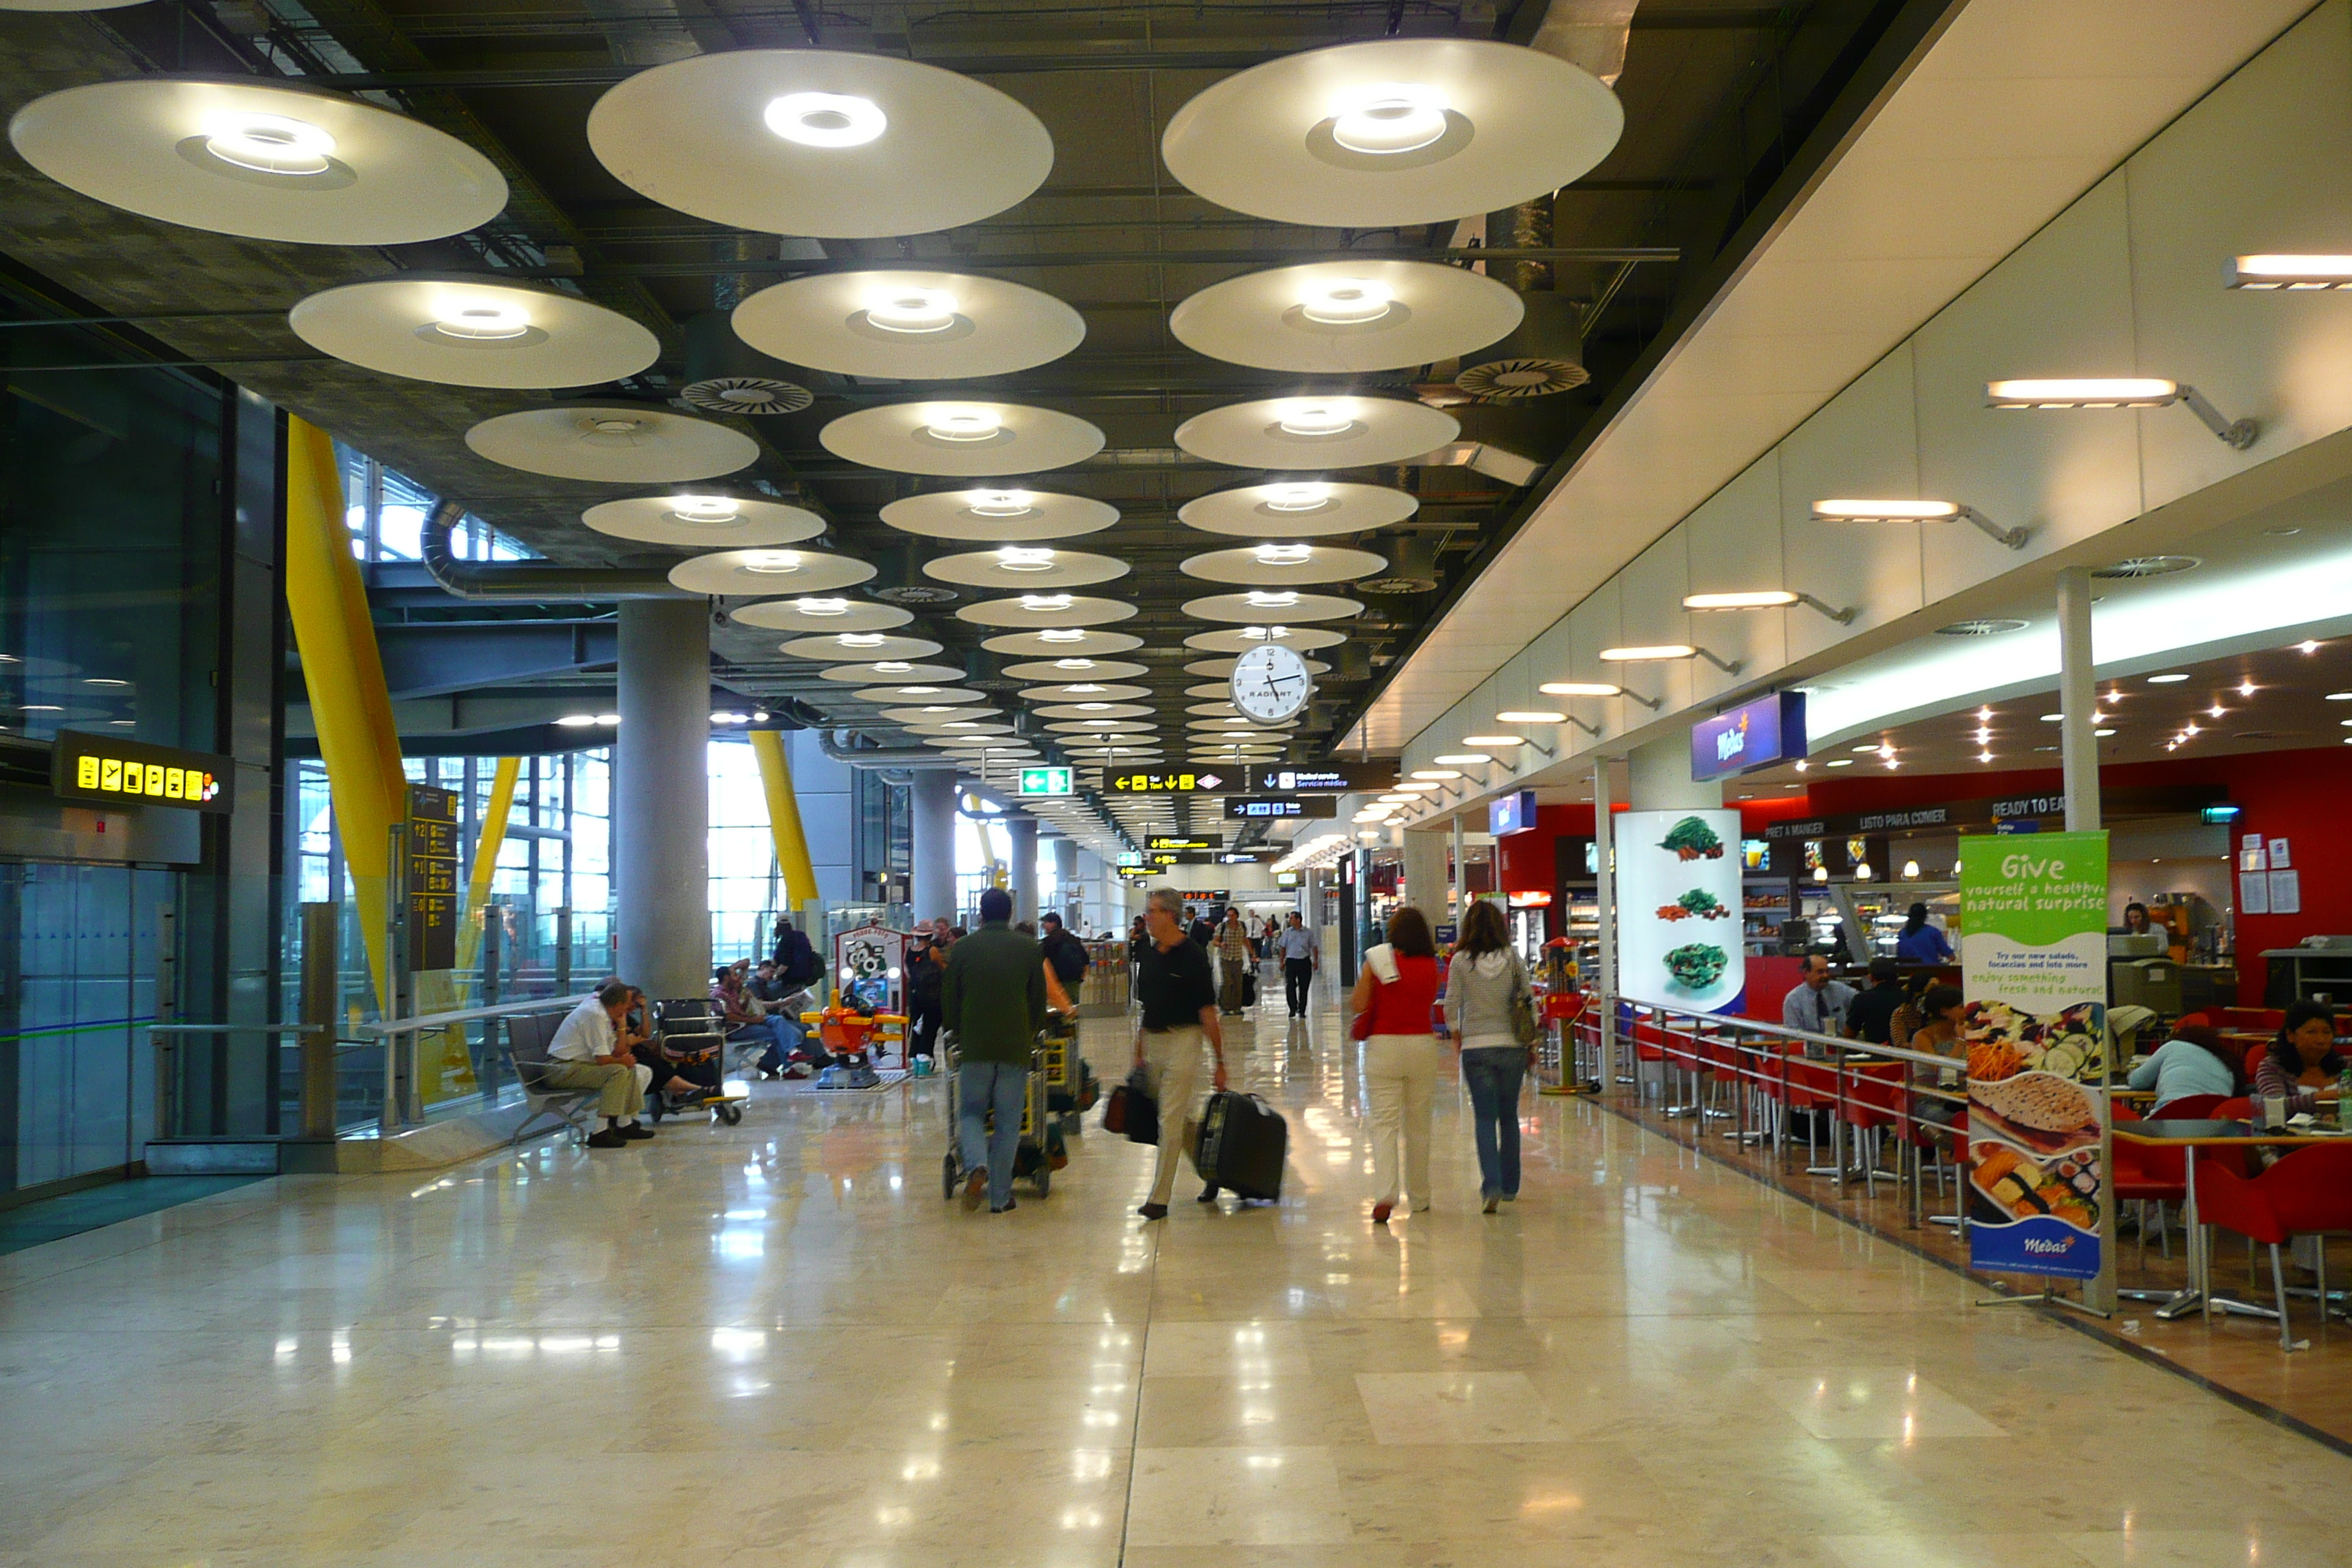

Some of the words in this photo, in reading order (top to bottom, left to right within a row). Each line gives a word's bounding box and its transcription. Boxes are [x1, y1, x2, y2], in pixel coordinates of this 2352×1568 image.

[1267, 649, 1275, 657] 12
[1993, 800, 2029, 816] READY
[2031, 798, 2048, 813] TO
[2049, 796, 2066, 811] EA
[1860, 815, 1884, 830] LISTO
[1885, 813, 1910, 827] PARA
[1911, 809, 1946, 824] COMER
[2001, 854, 2065, 881] Give
[1966, 882, 2024, 897] yourself
[2030, 885, 2038, 894] a
[1967, 896, 2029, 911] natural
[2035, 894, 2106, 912] surprise
[1997, 951, 2009, 960] Try
[2008, 972, 2067, 984] something
[1999, 984, 2028, 995] fresh
[2032, 985, 2054, 995] and
[2024, 1238, 2068, 1254] Medas
